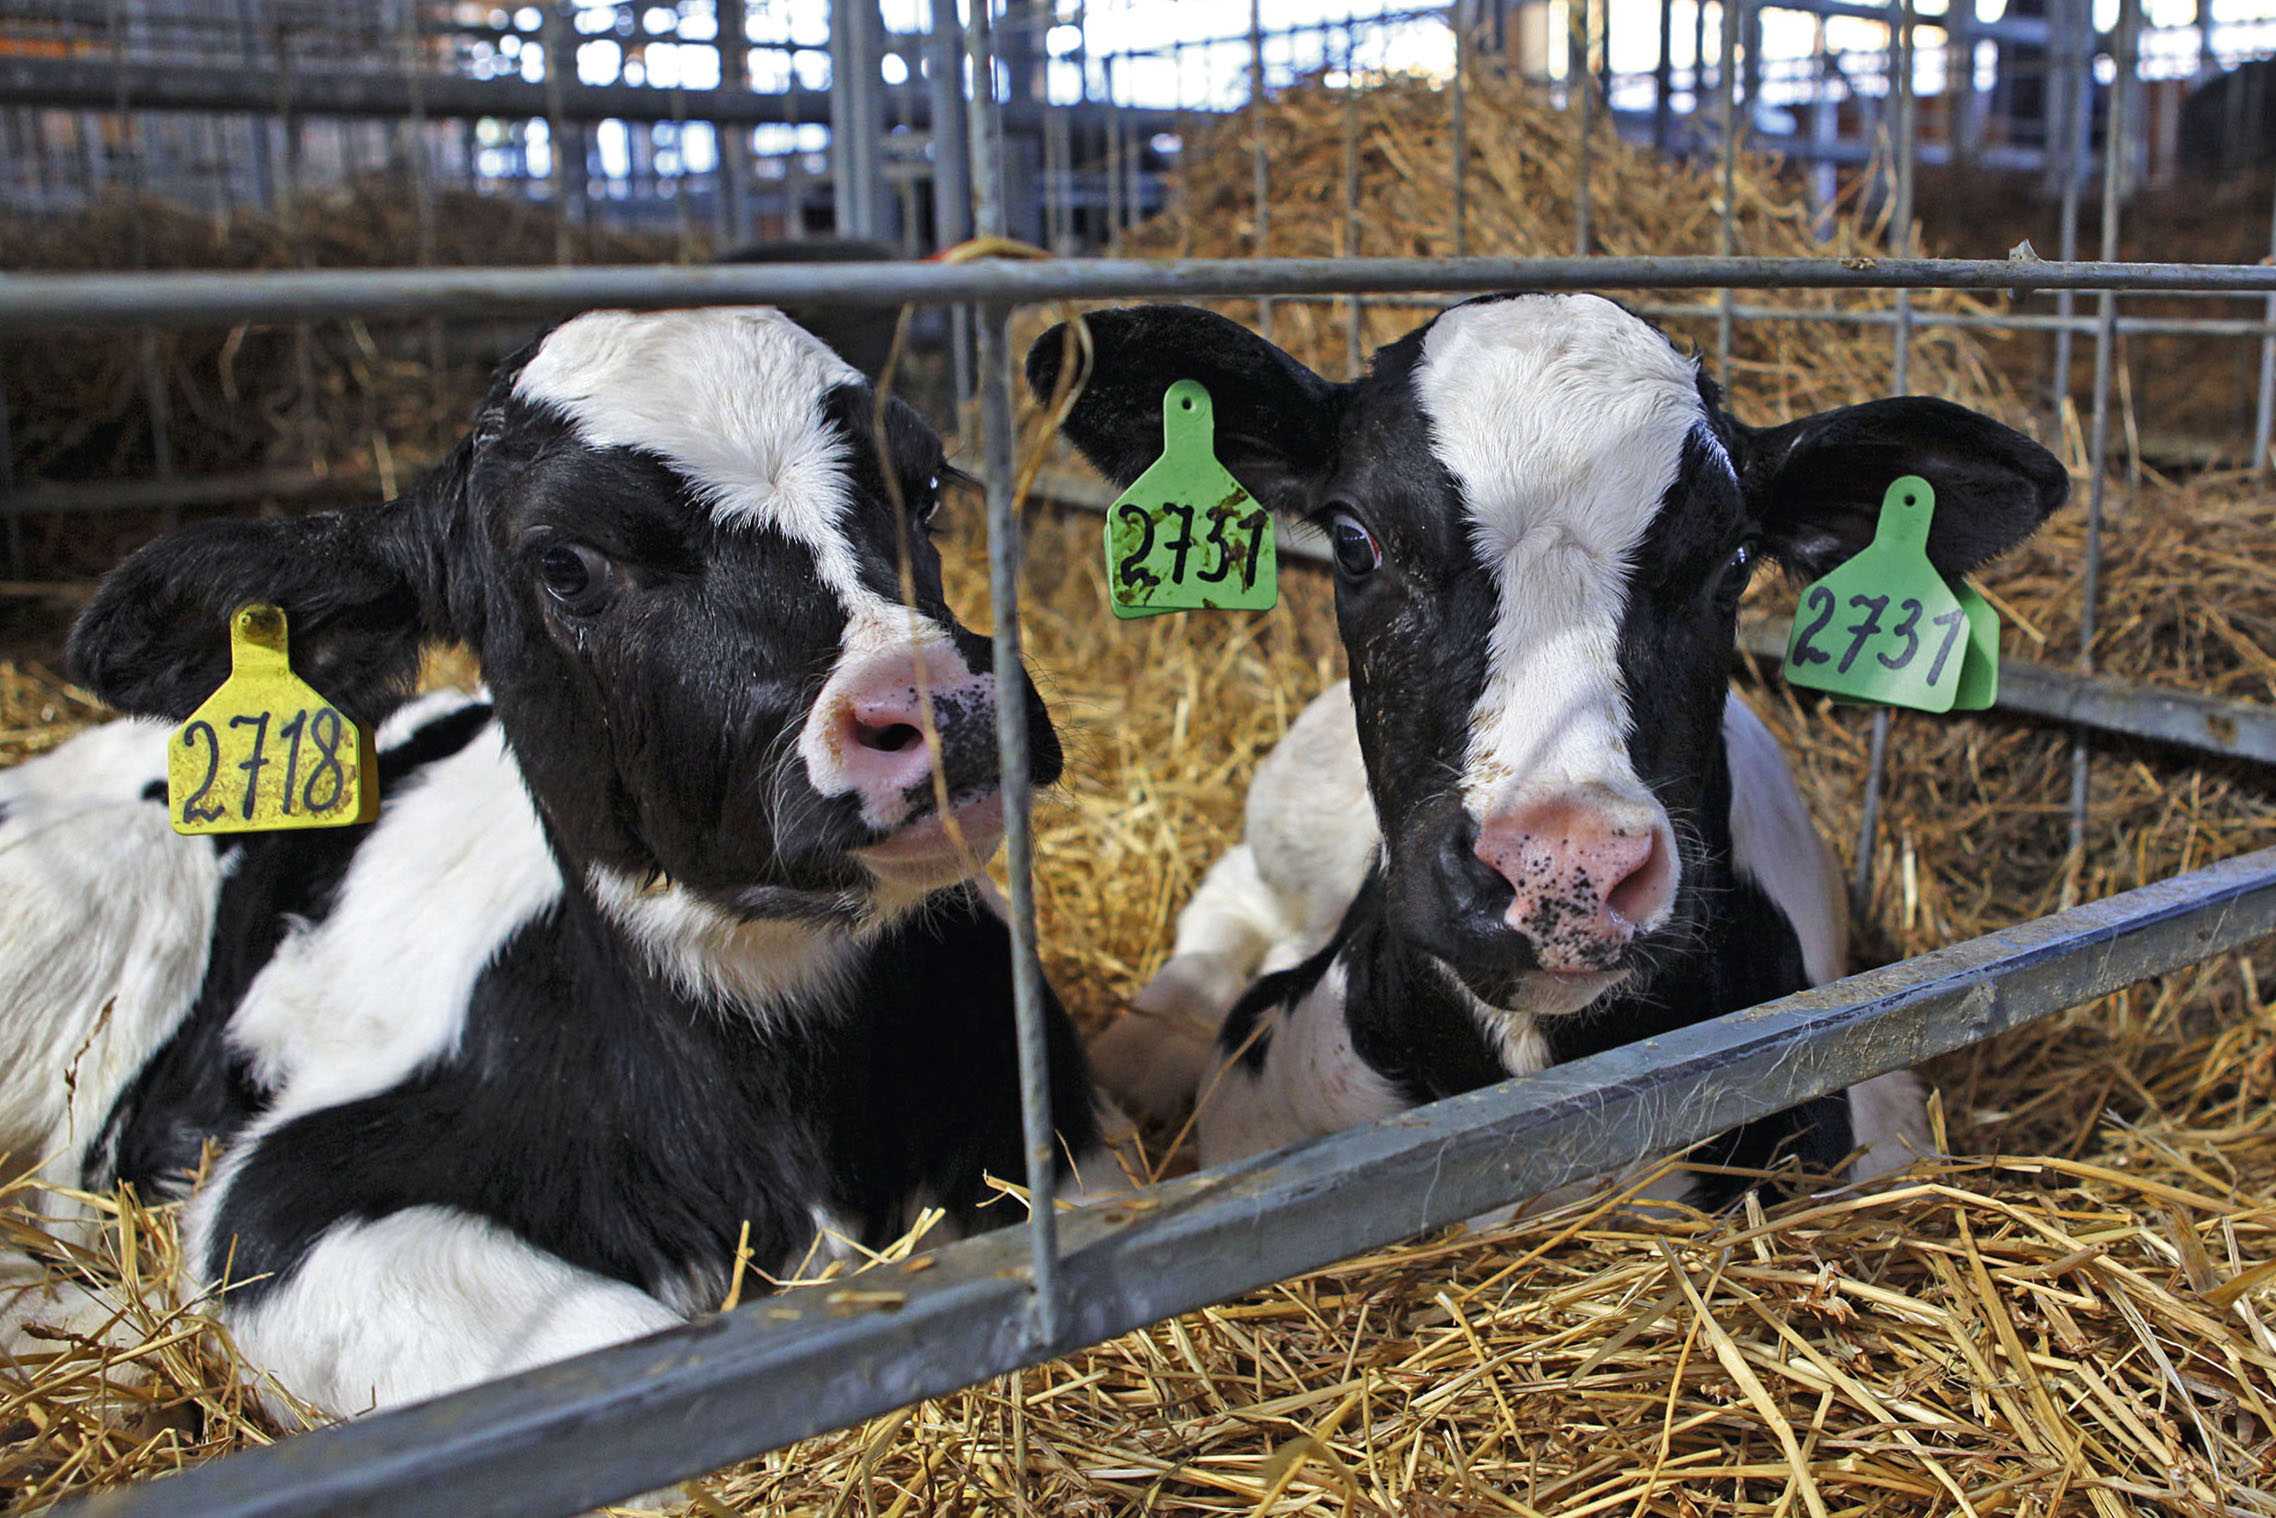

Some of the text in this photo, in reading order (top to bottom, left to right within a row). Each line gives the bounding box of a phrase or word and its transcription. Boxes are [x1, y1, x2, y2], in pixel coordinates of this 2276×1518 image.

[1118, 502, 1269, 588] 2731
[1792, 586, 1965, 686] 2731
[183, 707, 344, 824] 2718
